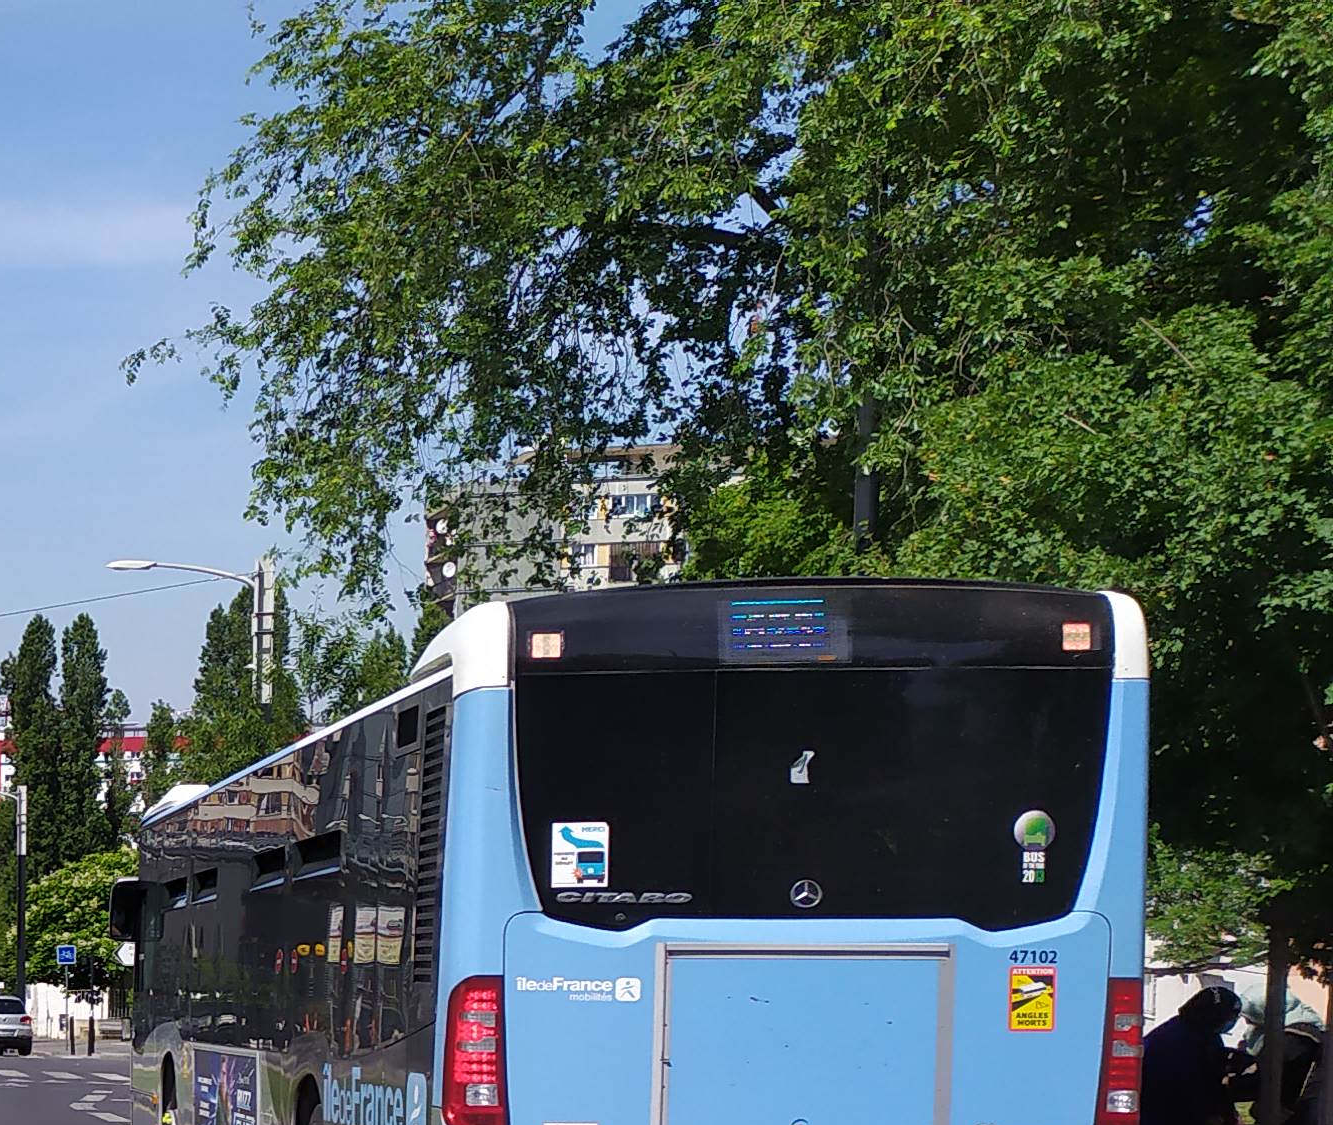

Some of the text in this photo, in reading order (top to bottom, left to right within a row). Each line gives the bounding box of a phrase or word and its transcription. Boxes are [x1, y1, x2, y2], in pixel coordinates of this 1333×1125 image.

[1023, 851, 1046, 863] BUS
[1022, 869, 1045, 883] 2013
[556, 891, 693, 904] CITARO
[1009, 950, 1058, 964] 47102
[569, 992, 613, 1002] mobilités
